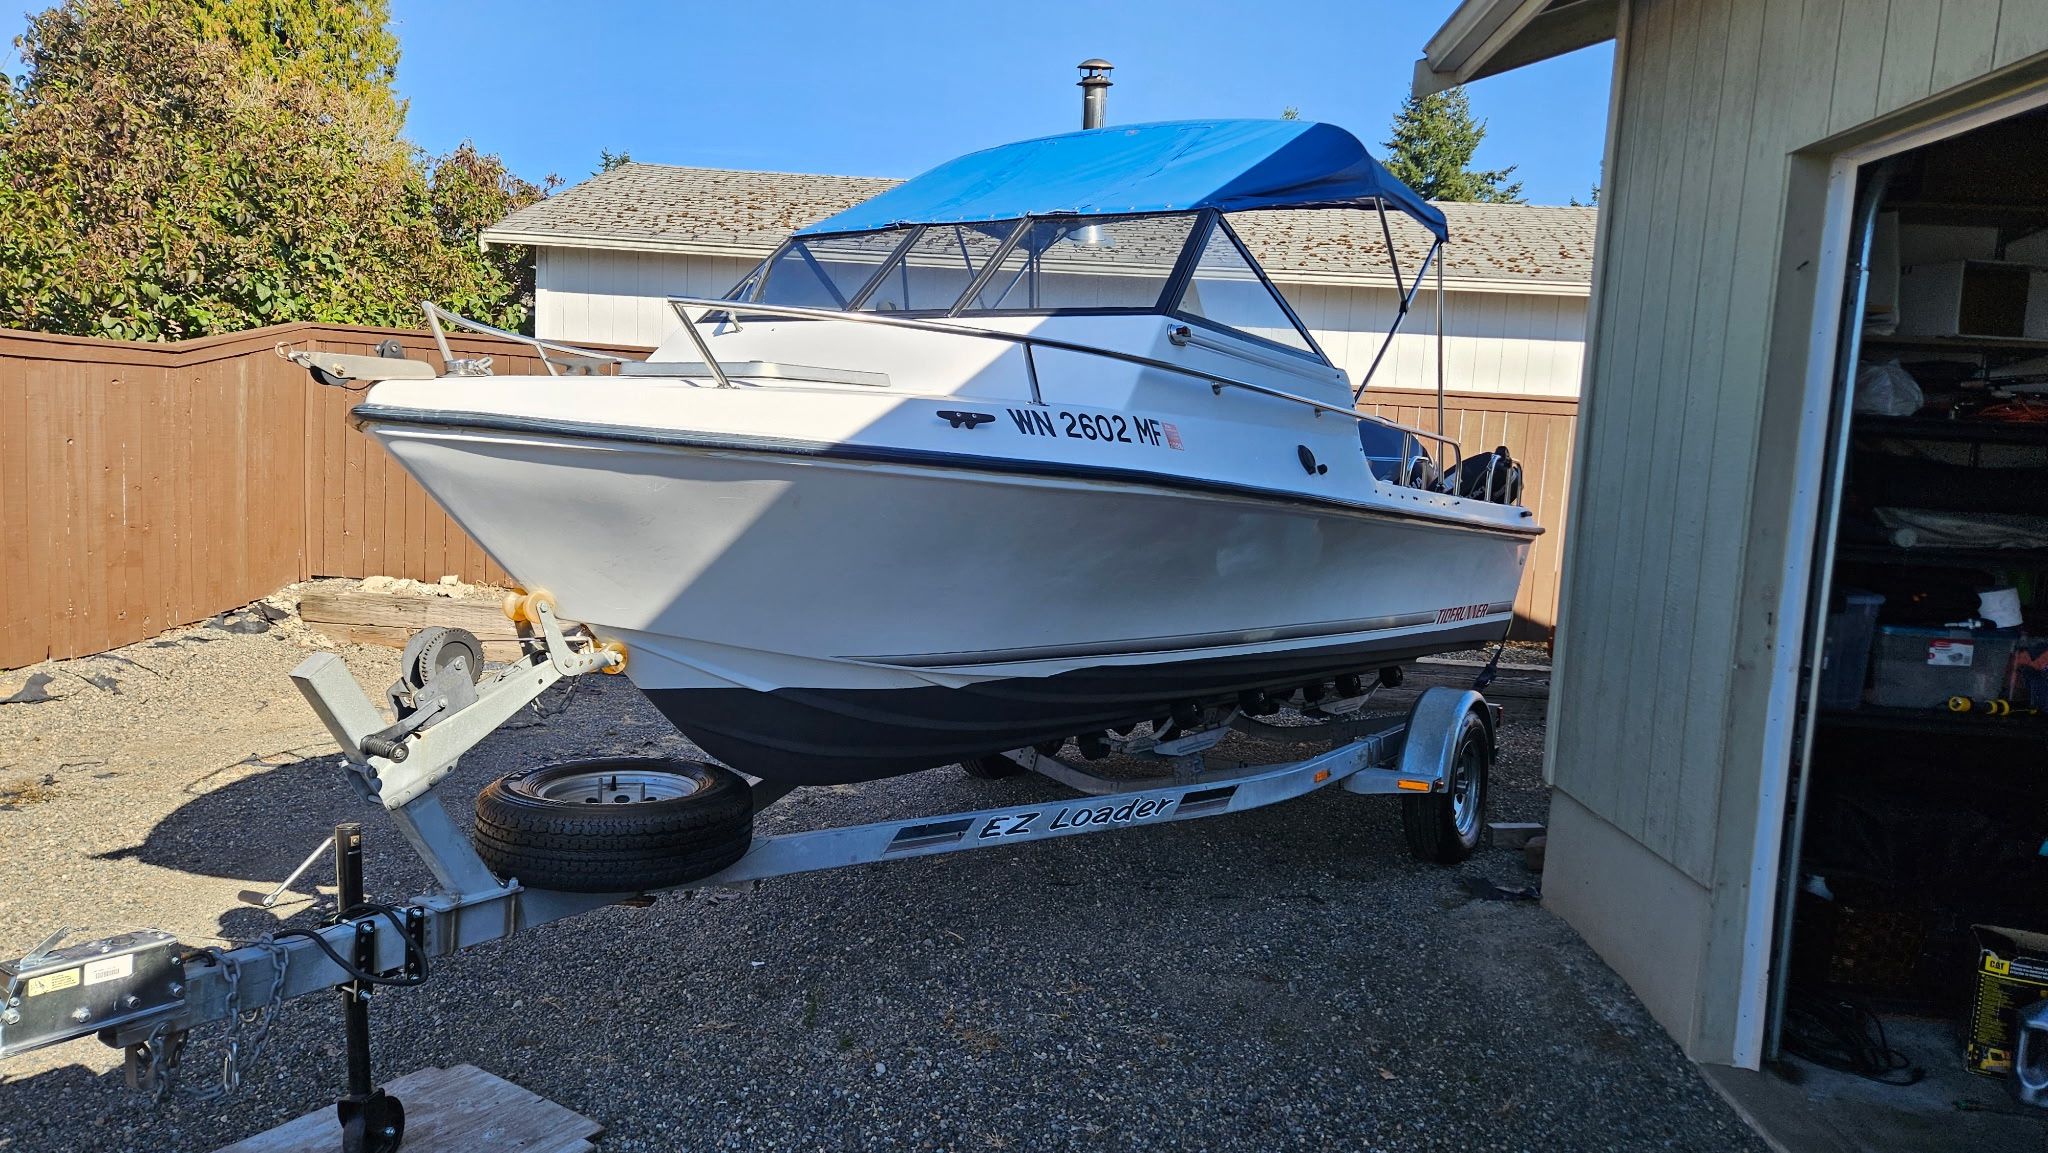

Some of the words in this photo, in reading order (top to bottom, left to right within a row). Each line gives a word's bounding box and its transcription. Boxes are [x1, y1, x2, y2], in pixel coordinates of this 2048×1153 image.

[1006, 408, 1056, 437] WN
[1060, 411, 1132, 443] 2602
[1133, 415, 1161, 447] MF
[978, 812, 1040, 840] EZ
[1048, 797, 1175, 831] Loader
[1990, 960, 2005, 970] CAT
